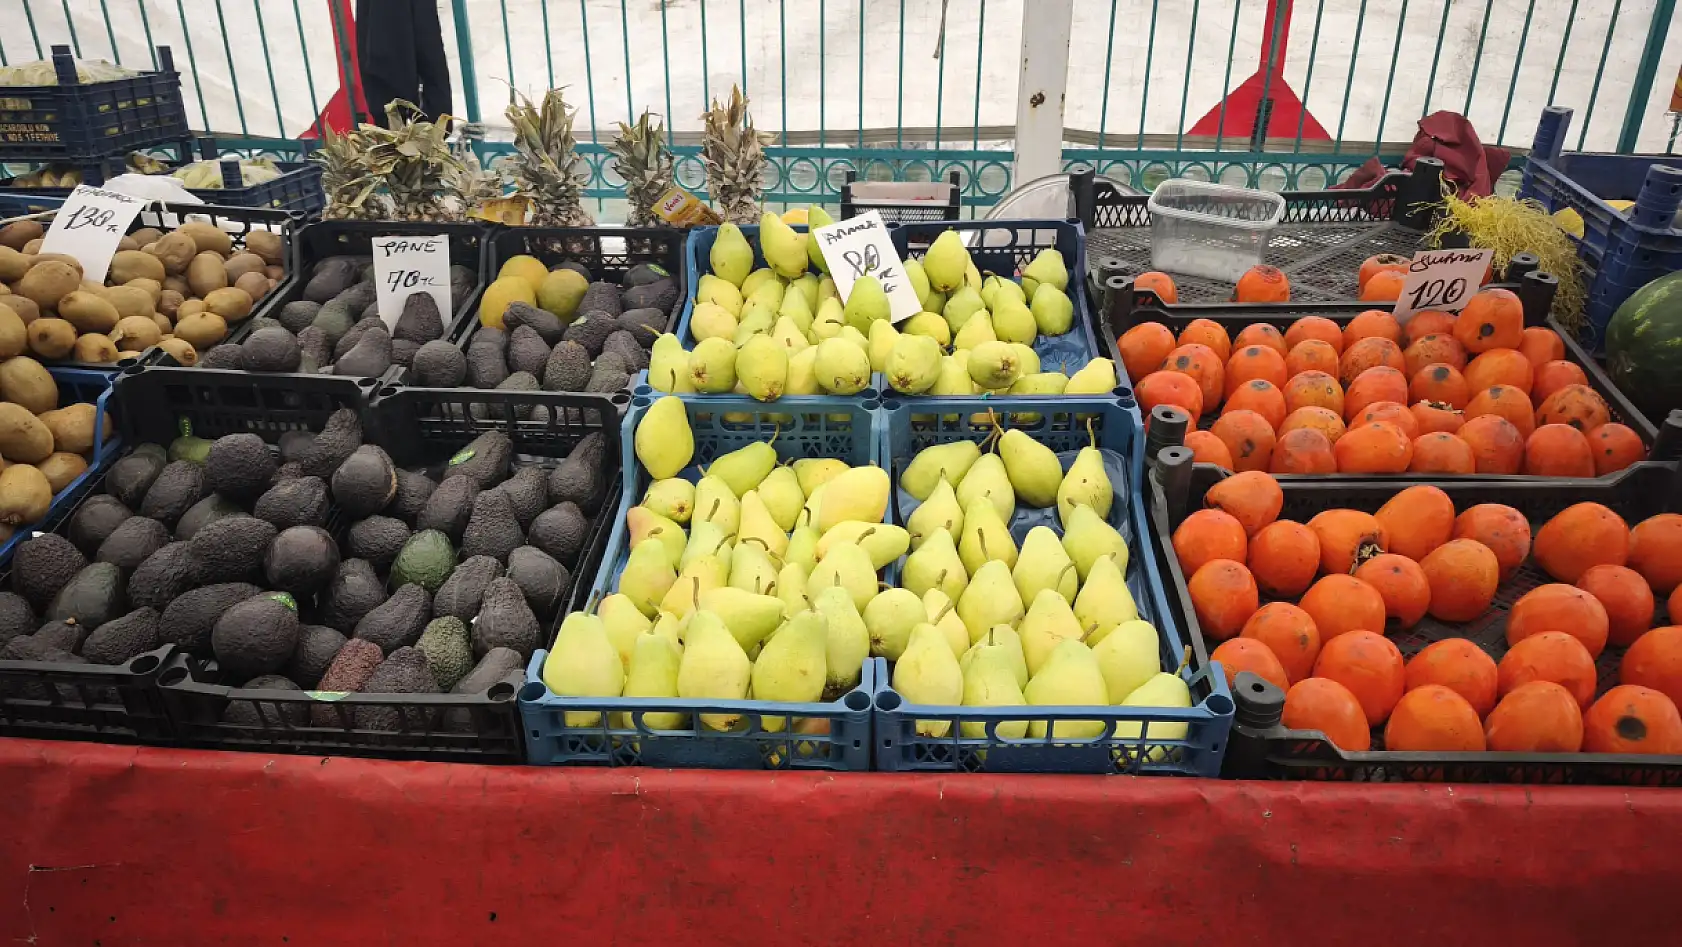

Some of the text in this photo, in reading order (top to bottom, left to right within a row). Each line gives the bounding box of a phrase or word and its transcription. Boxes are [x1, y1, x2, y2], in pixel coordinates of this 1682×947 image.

[63, 205, 116, 230] 130
[386, 270, 421, 293] 70
[1408, 277, 1467, 310] 120
